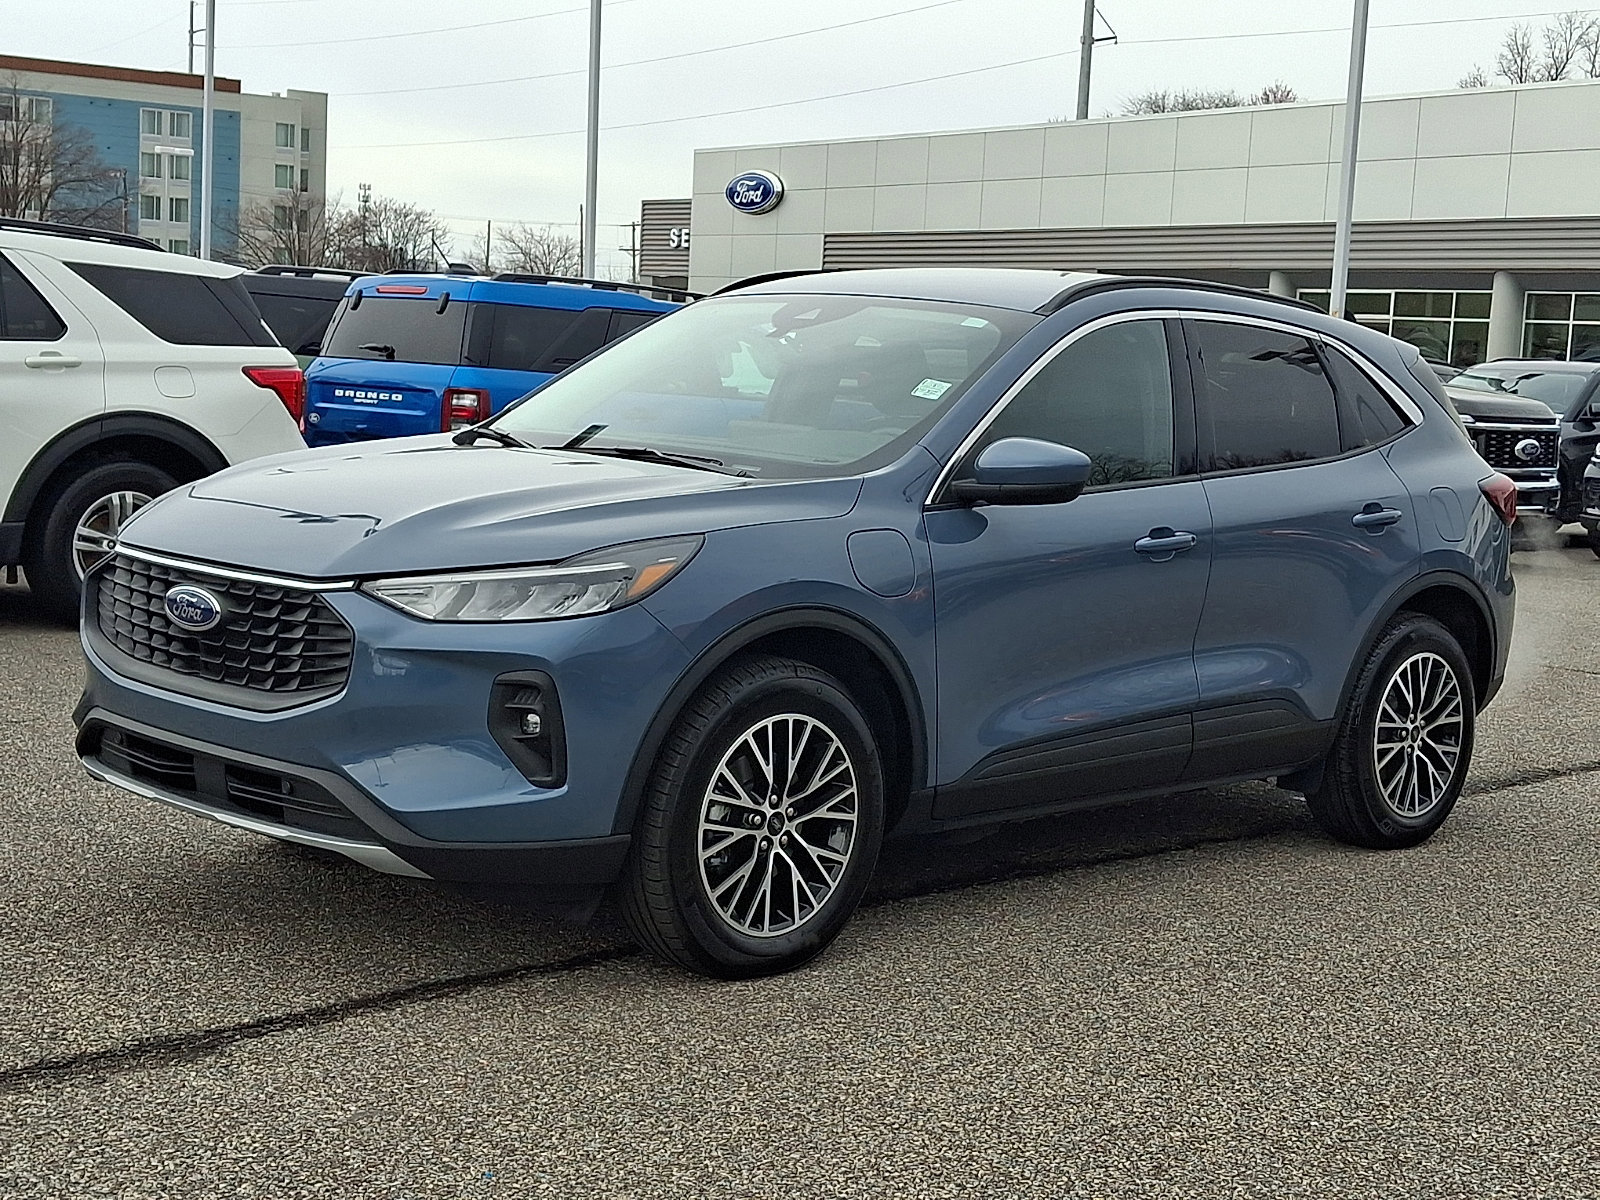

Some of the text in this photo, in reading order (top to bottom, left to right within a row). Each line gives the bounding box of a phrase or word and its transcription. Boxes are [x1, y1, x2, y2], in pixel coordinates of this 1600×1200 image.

[734, 180, 764, 204] Ford
[334, 389, 403, 401] BRONCO
[172, 593, 204, 621] Ford
